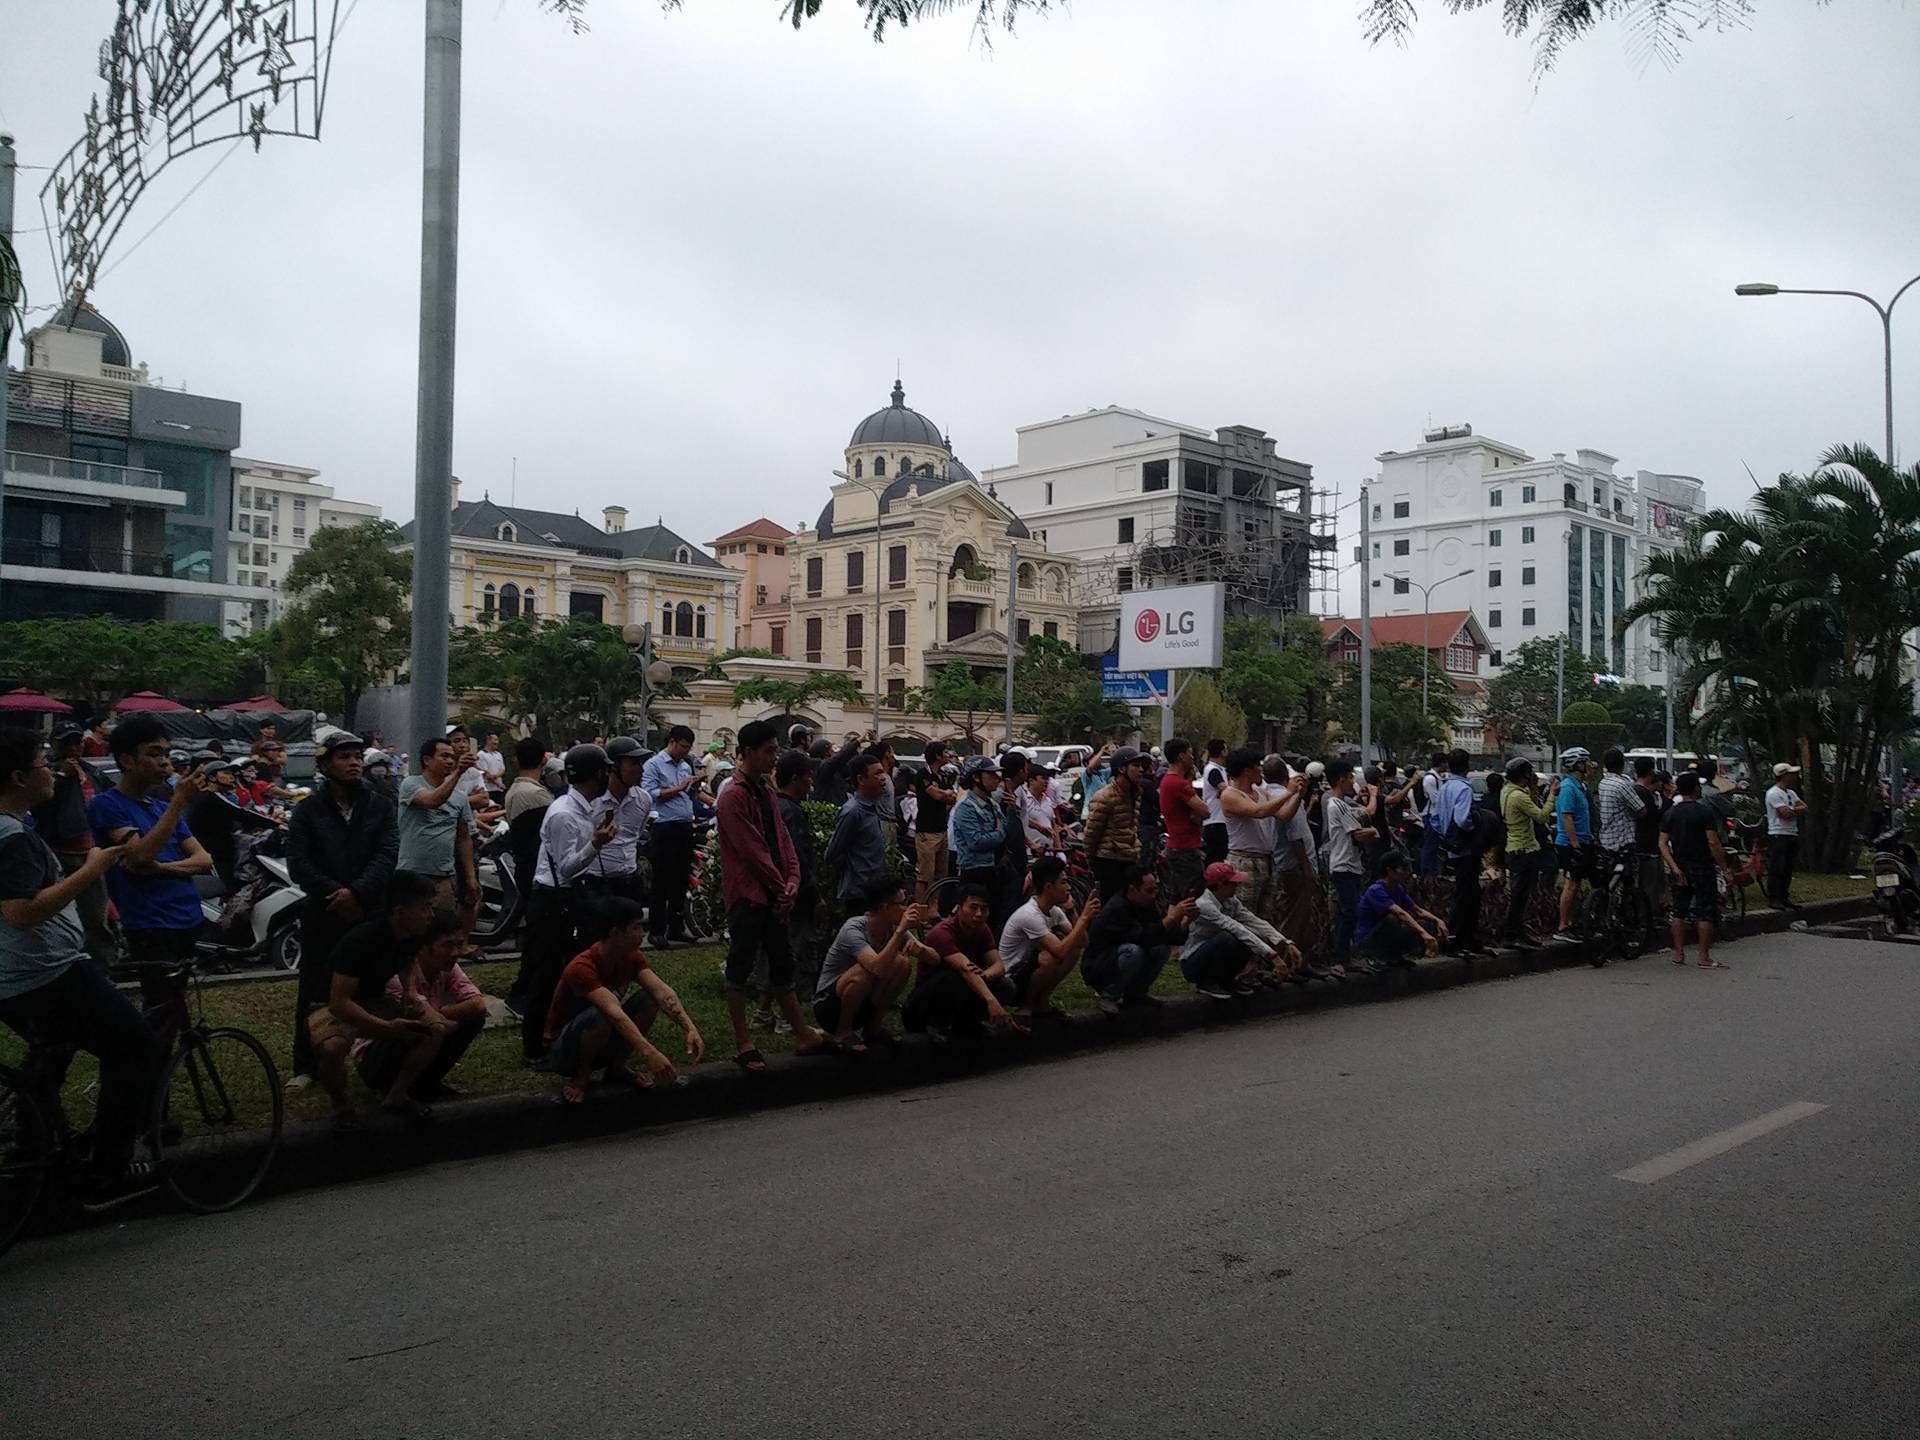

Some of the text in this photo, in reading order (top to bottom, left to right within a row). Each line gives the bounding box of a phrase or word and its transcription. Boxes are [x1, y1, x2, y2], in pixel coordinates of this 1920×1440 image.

[1165, 610, 1195, 635] LG
[1164, 639, 1200, 649] Life's Good
